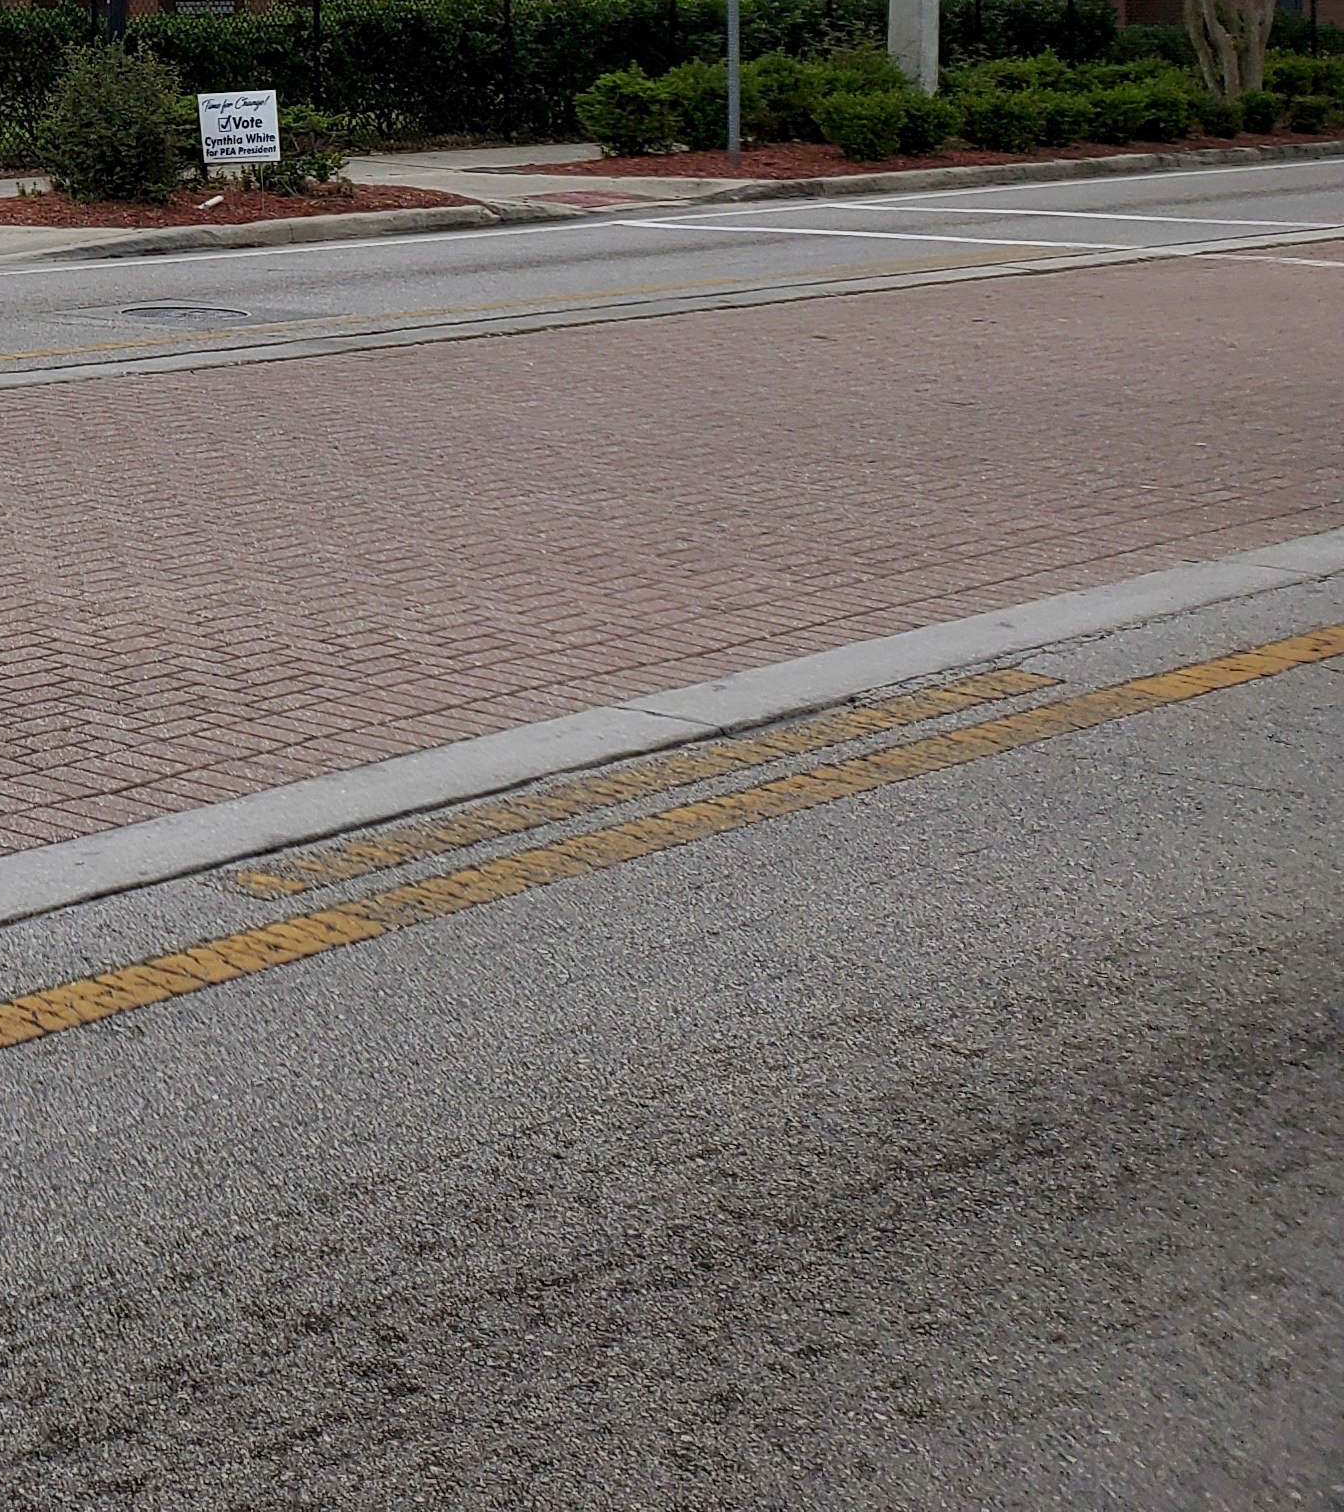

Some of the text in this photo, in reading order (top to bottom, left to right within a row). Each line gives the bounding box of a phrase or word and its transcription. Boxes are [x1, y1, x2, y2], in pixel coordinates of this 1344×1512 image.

[220, 99, 233, 114] for
[235, 95, 270, 111] Change!
[233, 116, 263, 129] Vote
[205, 132, 276, 149] Cynthia White
[206, 145, 277, 157] for PEA President
